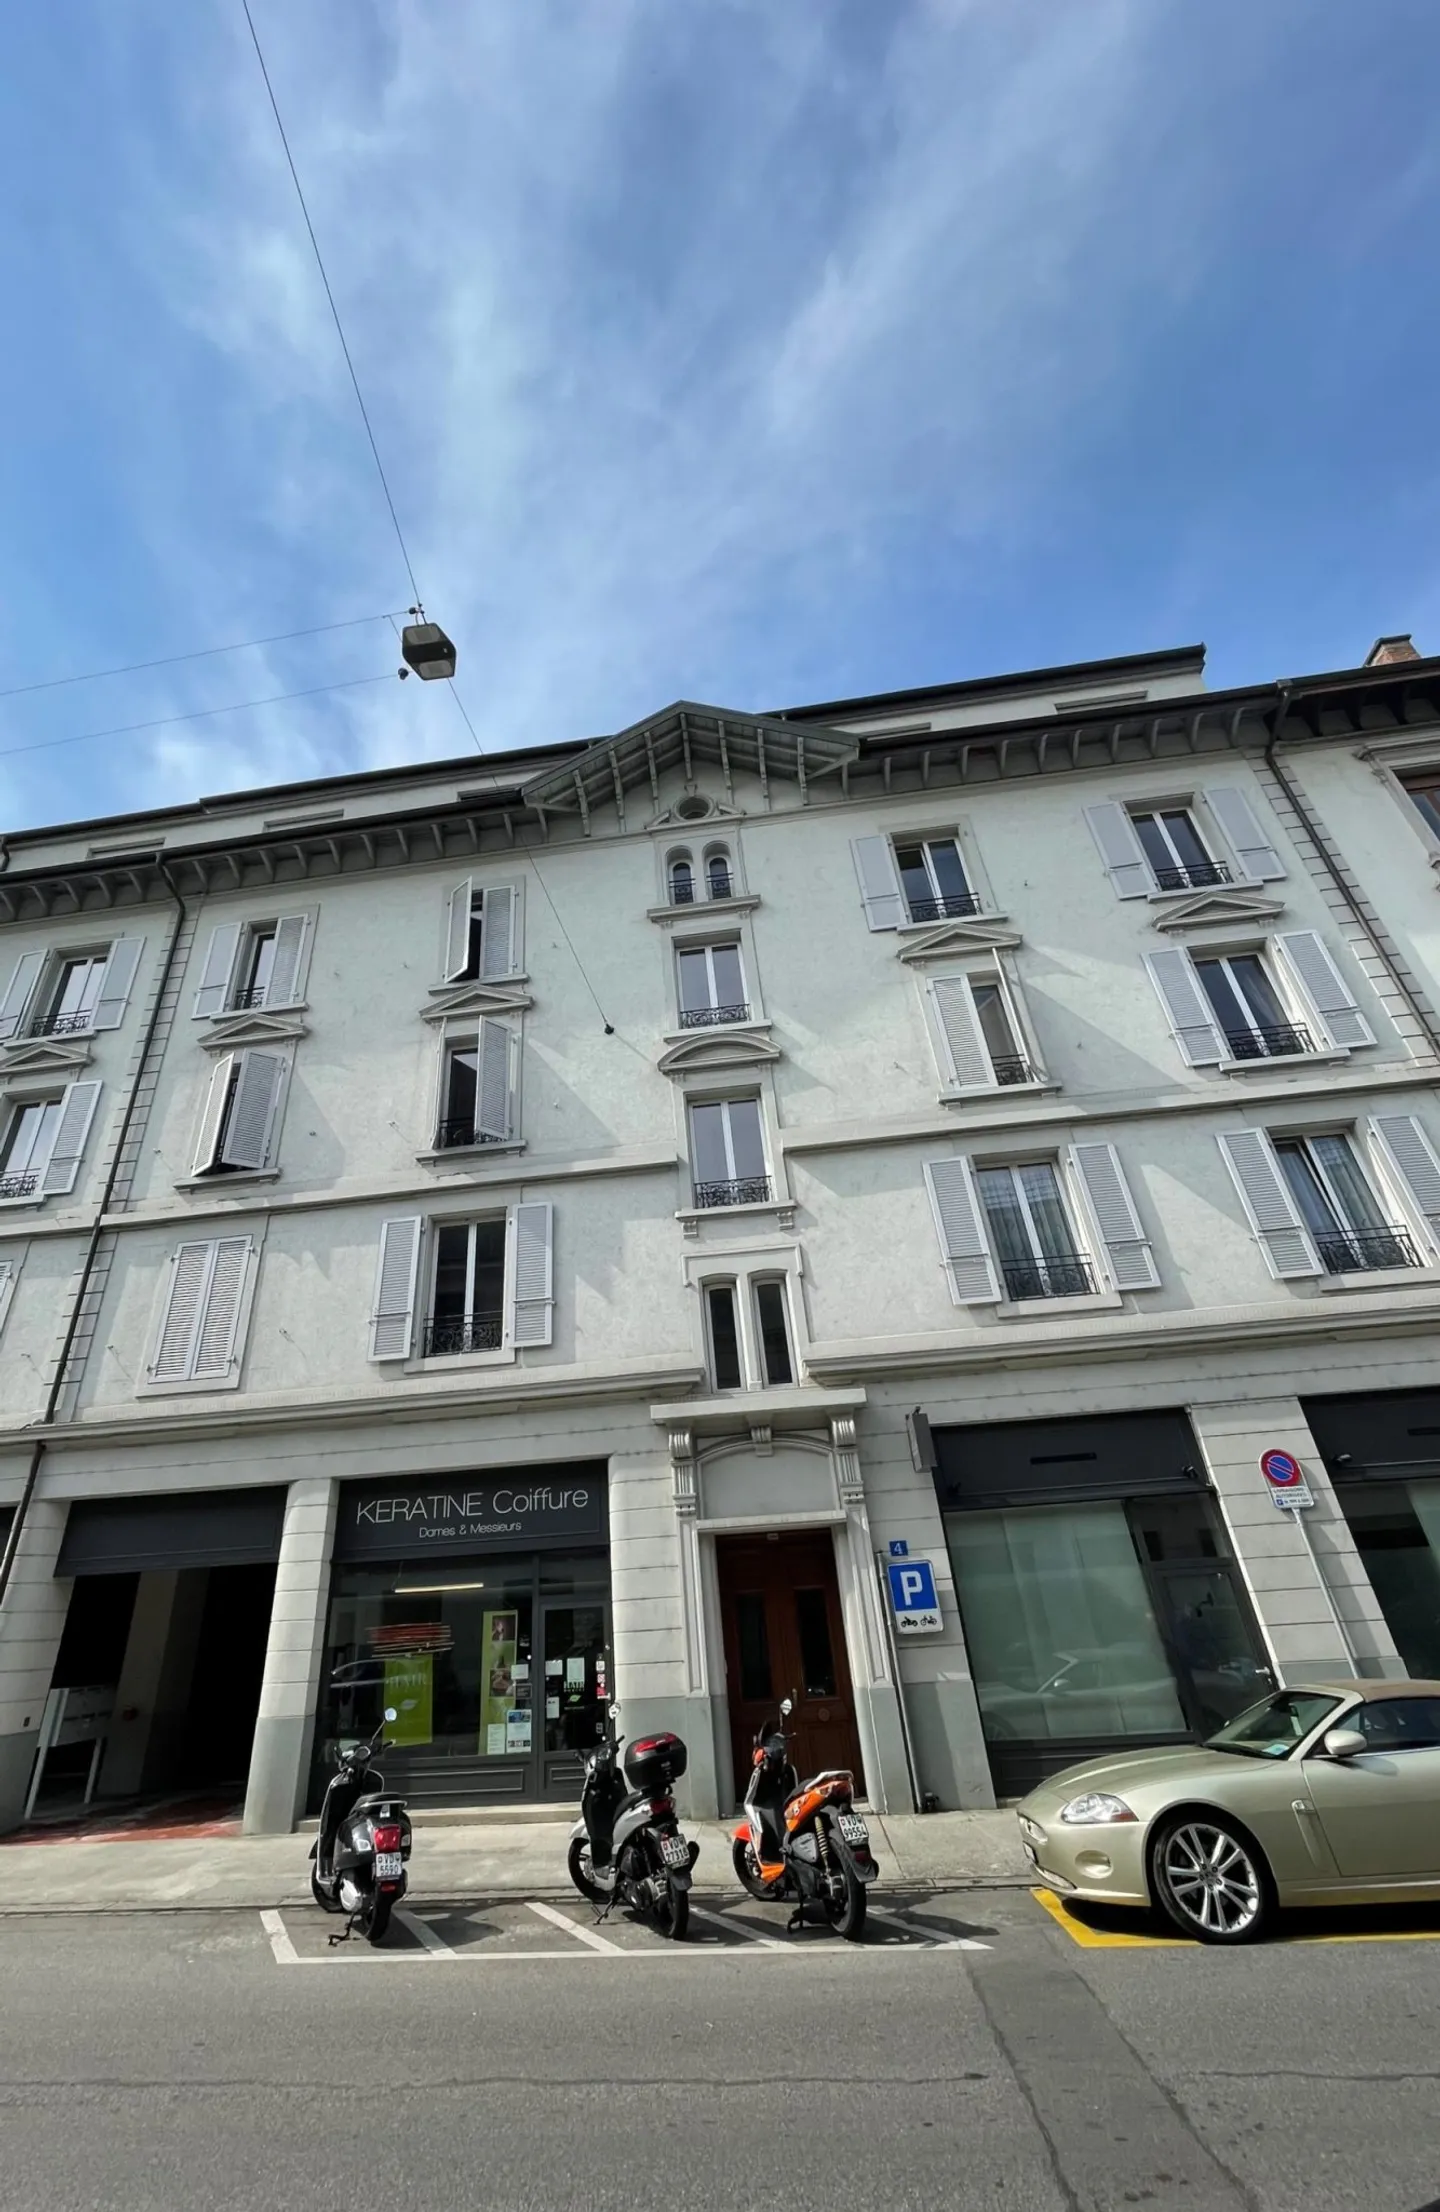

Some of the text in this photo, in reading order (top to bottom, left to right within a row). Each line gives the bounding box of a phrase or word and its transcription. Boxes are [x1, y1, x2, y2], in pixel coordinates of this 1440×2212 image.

[356, 1487, 589, 1525] KERATINE Coiffure
[418, 1521, 522, 1538] Dames & Messieurs
[894, 1542, 903, 1555] 4
[900, 1571, 923, 1606] P
